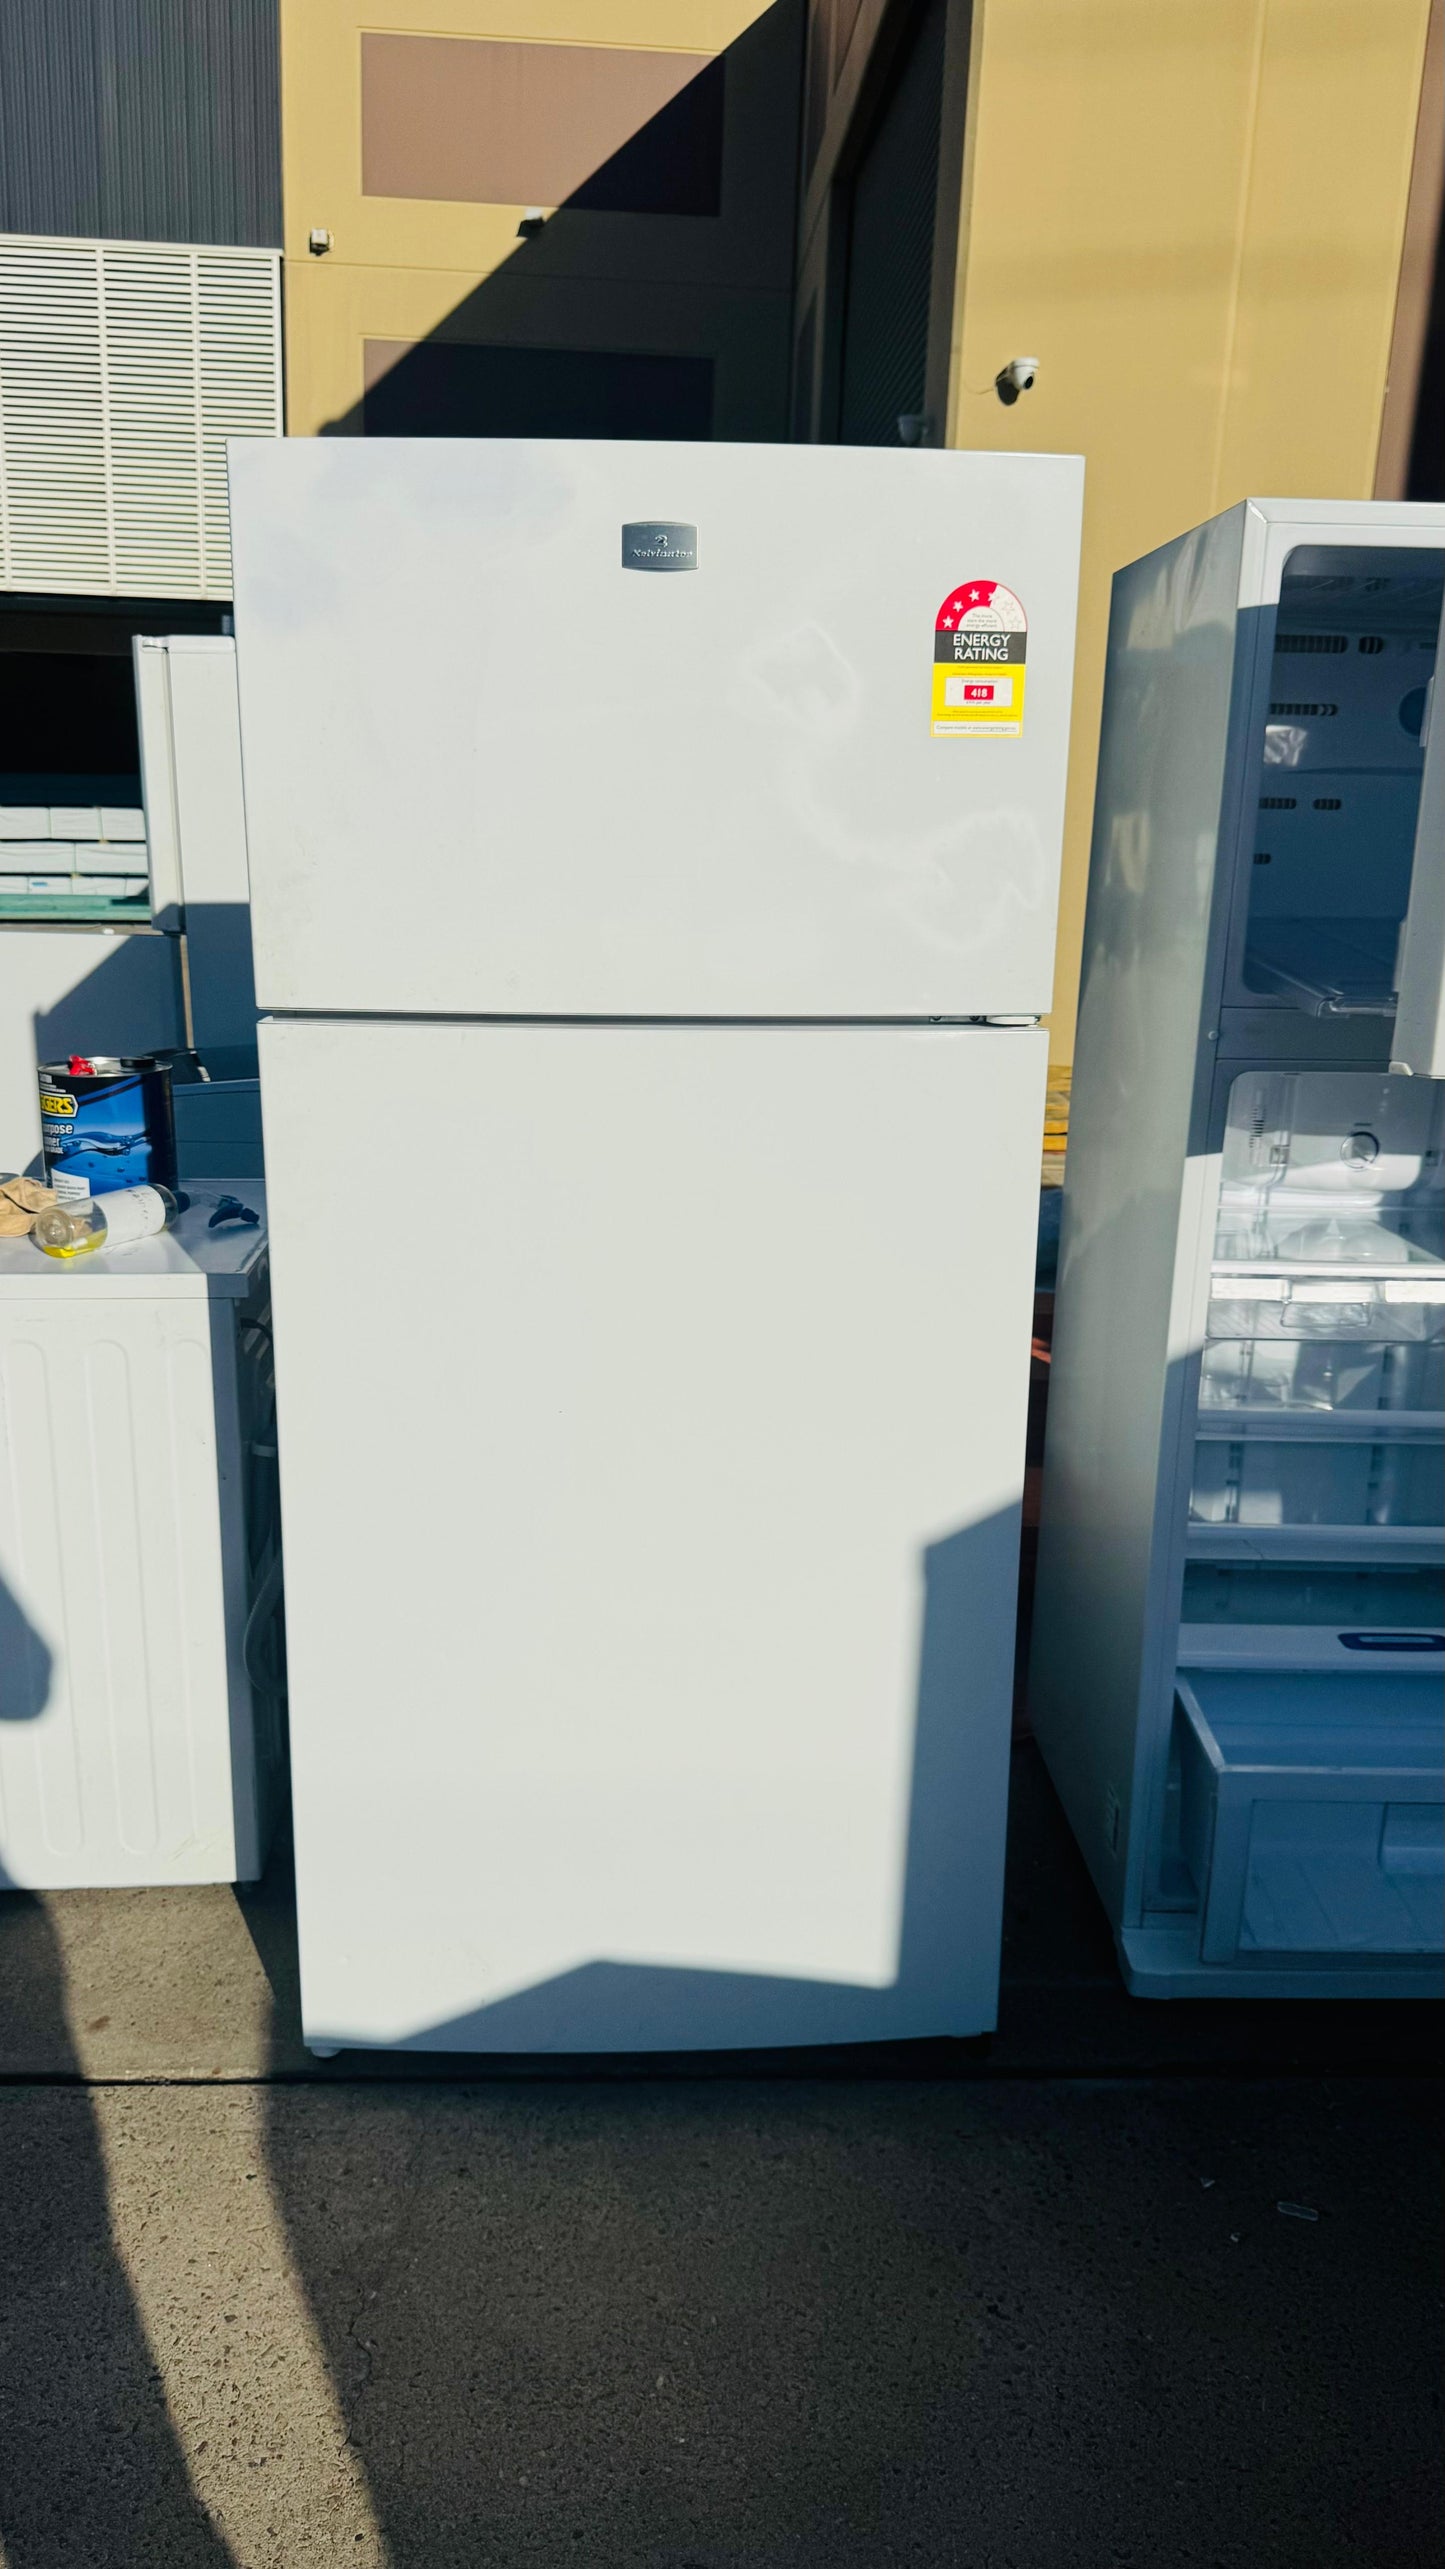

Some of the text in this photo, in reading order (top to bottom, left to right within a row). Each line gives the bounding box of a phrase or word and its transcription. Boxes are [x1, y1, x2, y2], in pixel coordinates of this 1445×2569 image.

[953, 633, 1011, 647] ENERGY
[954, 647, 1009, 661] RATING
[970, 688, 988, 698] 418
